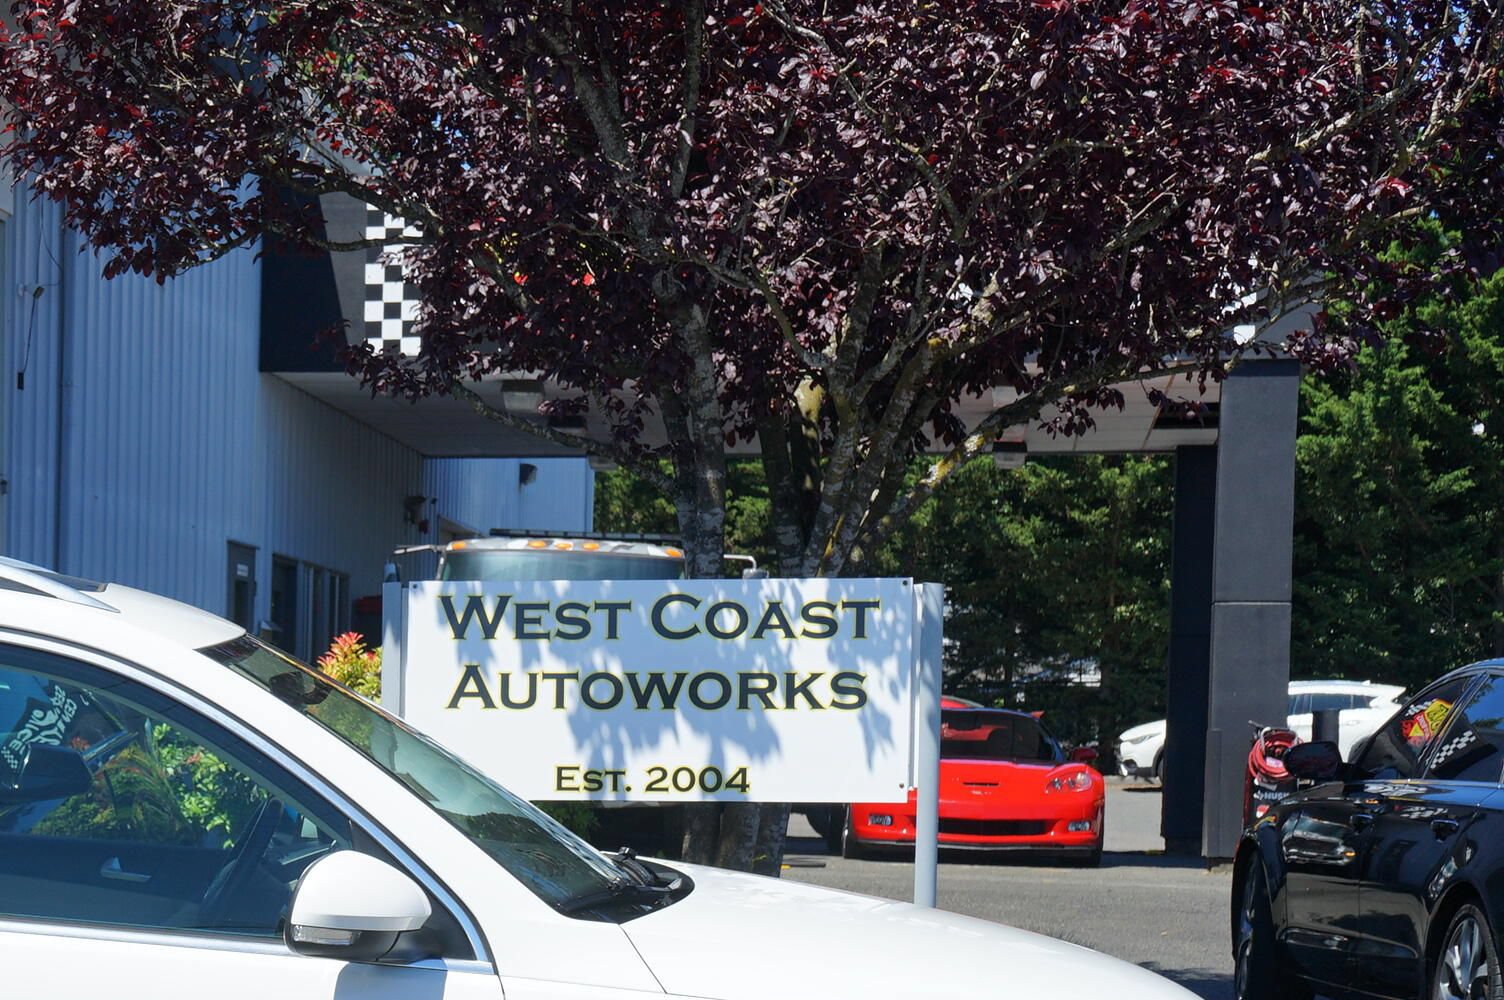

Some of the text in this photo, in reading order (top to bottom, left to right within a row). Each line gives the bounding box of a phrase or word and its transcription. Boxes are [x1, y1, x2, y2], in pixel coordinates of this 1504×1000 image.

[439, 593, 882, 642] WEST COAST
[445, 664, 869, 712] AUTOWORKS
[555, 765, 751, 794] EST. 2004
